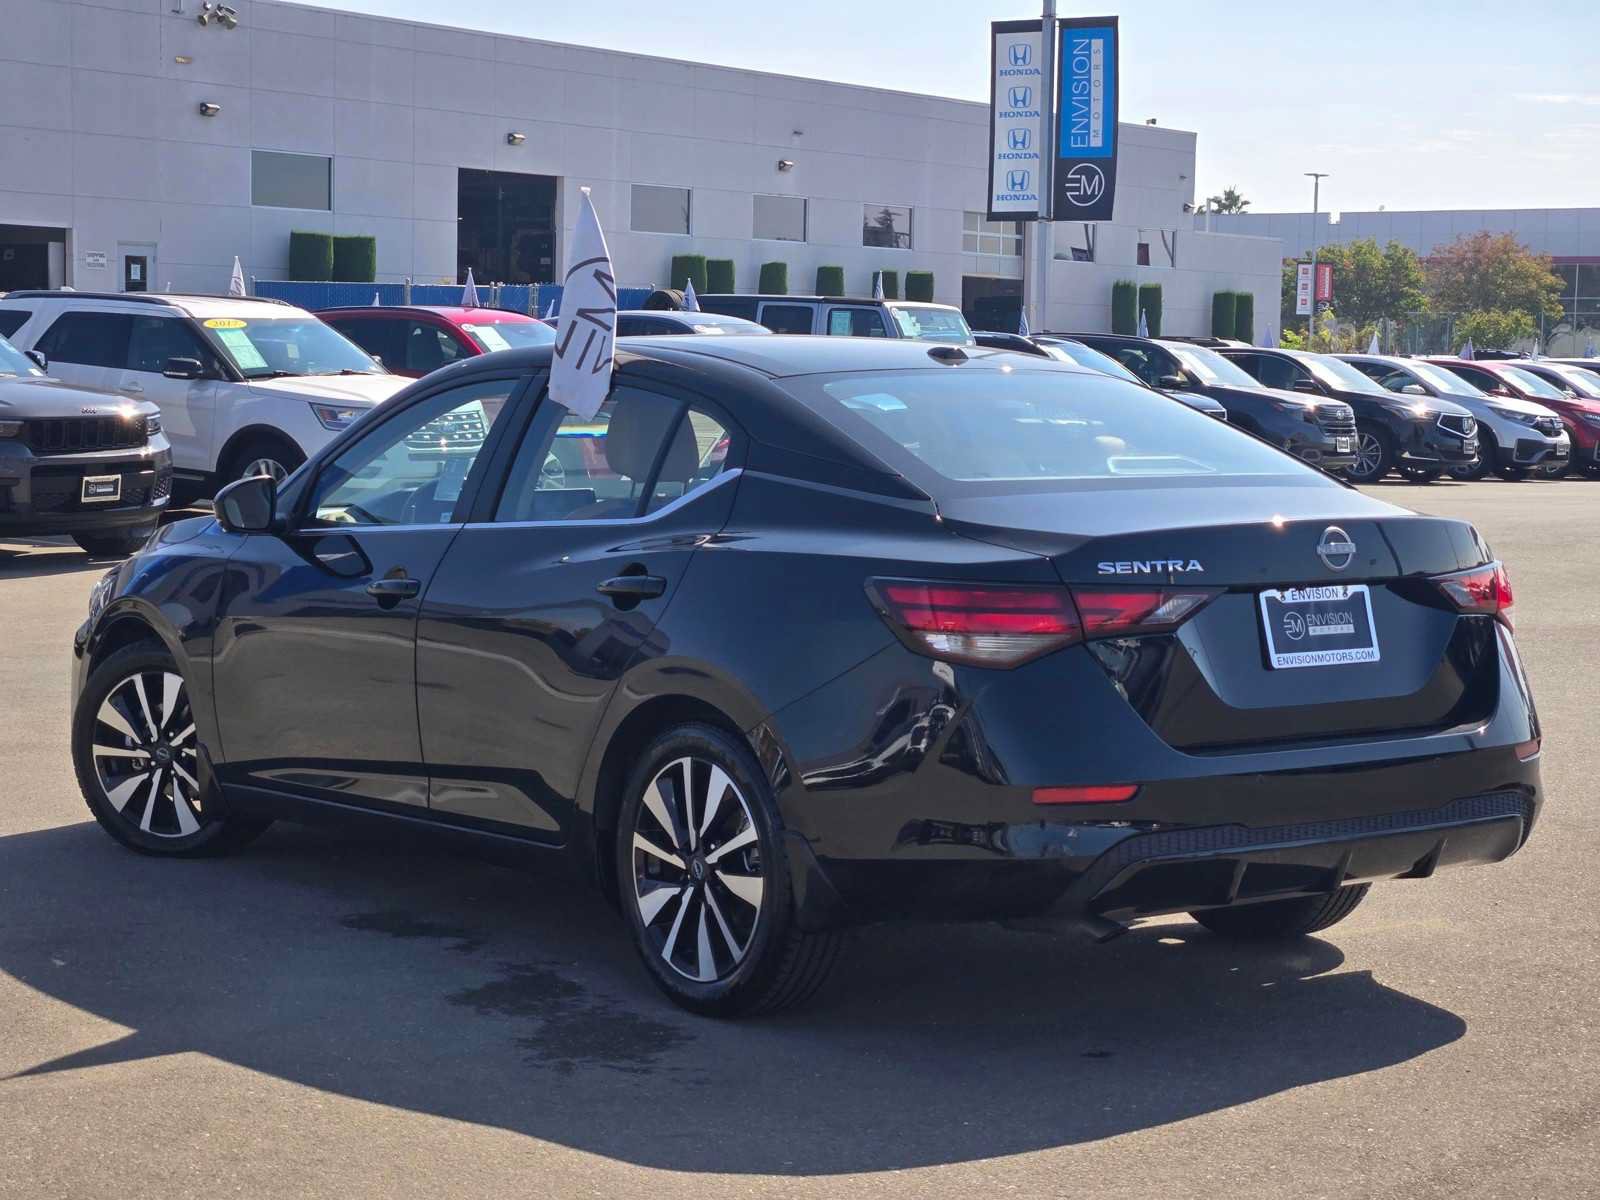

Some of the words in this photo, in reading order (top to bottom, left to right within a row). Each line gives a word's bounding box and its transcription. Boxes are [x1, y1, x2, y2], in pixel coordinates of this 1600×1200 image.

[999, 68, 1041, 77] HONDA
[1071, 39, 1089, 147] ENVISION
[1093, 49, 1101, 138] MOTORS
[999, 110, 1040, 118] HONDA
[998, 152, 1040, 160] HONDA
[1097, 560, 1204, 574] SENTRA
[1291, 588, 1339, 601] ENVISION
[1306, 612, 1354, 626] ENVISION
[1276, 651, 1375, 666] ENVISIONMOTORS.COM
